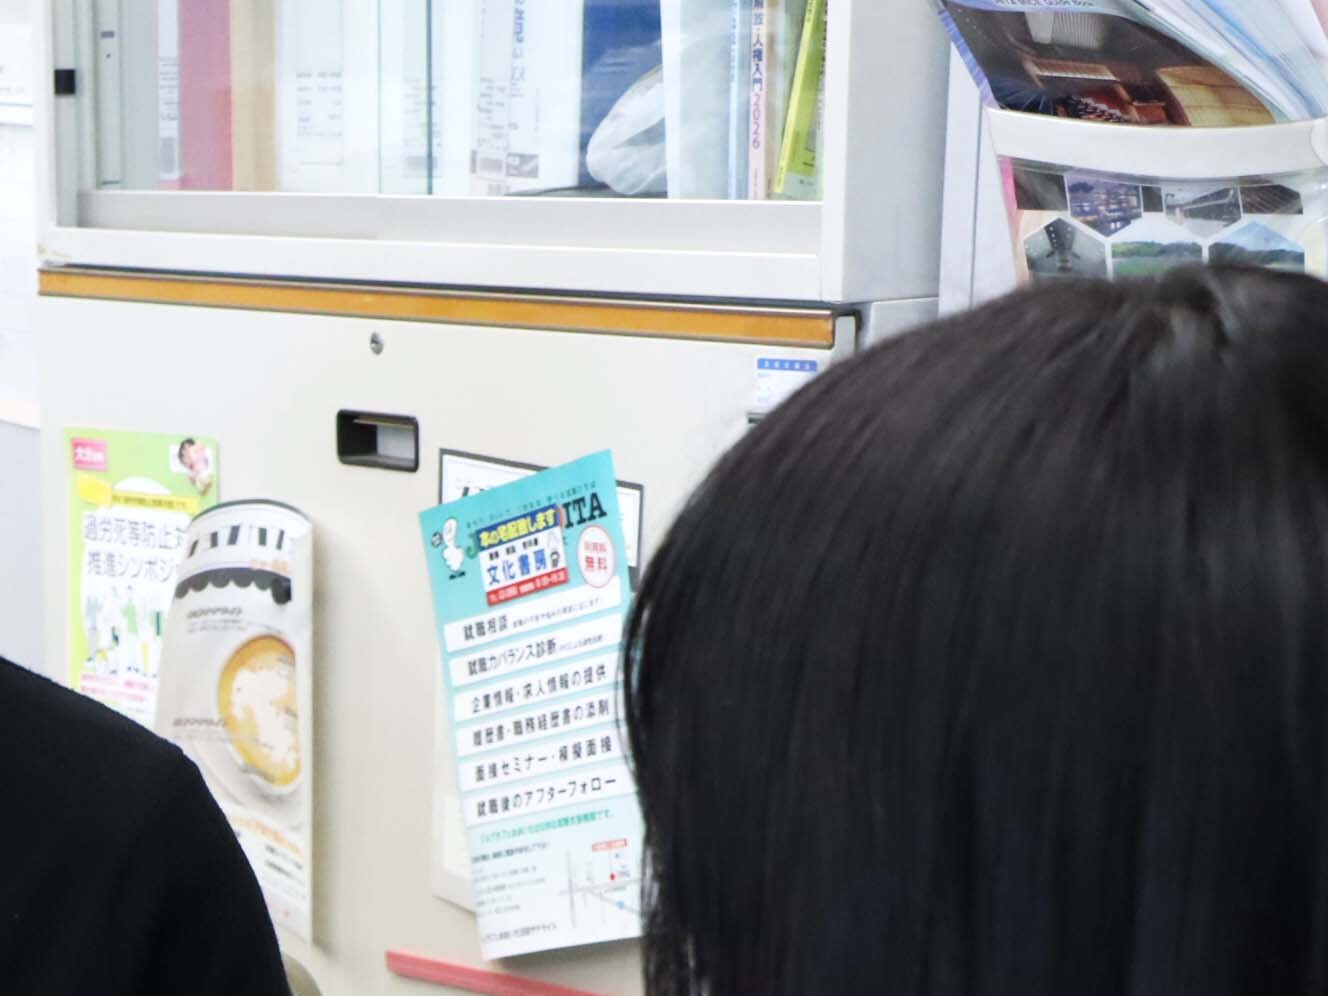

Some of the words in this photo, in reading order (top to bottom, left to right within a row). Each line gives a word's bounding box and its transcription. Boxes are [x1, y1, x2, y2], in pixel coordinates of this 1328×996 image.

[560, 492, 608, 530] ITA
[487, 549, 548, 585] 文化書房
[463, 615, 508, 641] 就職相談
[477, 776, 617, 817] 就職後のアフターフォロー
